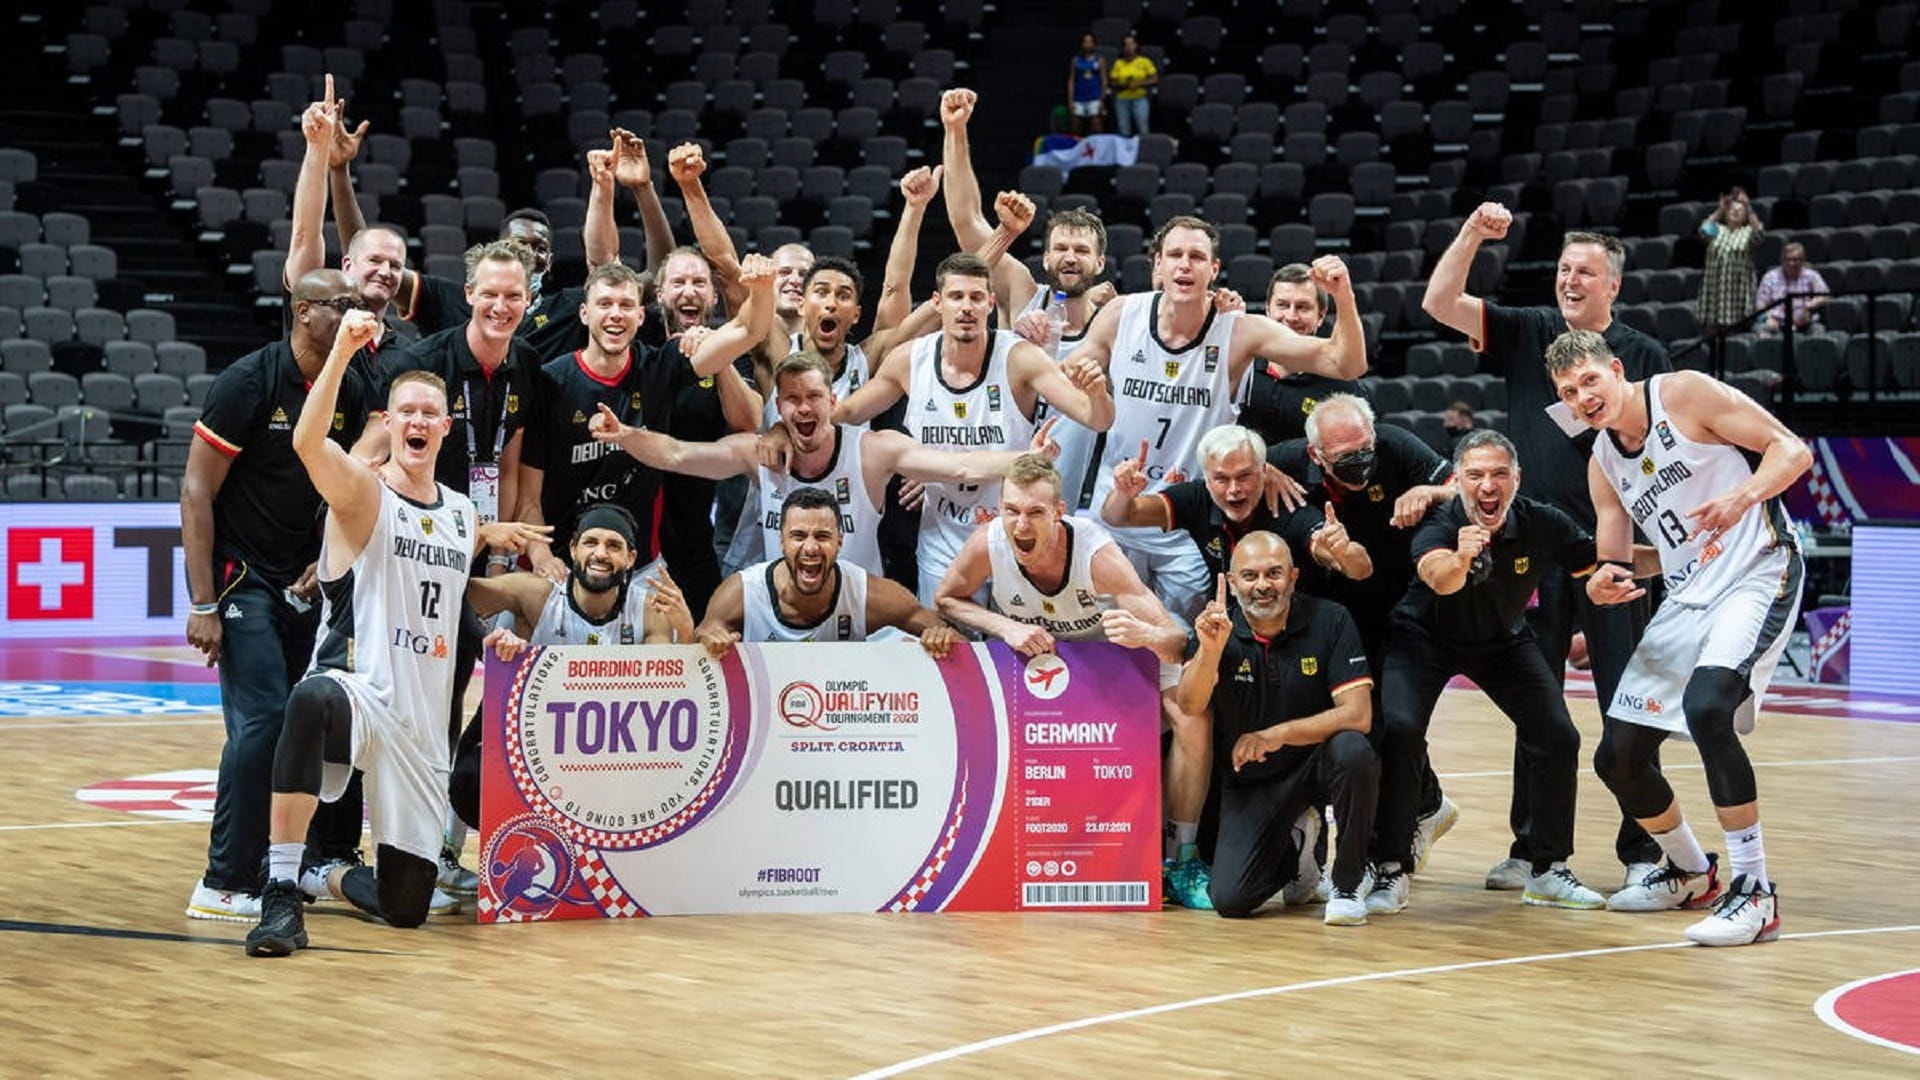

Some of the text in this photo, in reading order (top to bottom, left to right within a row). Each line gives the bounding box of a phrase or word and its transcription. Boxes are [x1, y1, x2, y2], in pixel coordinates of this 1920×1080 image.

[1123, 378, 1211, 408] DEUTSCHLAND
[922, 425, 1005, 446] DEUTSCHLAND
[1155, 418, 1172, 450] 7
[1658, 509, 1688, 549] 13
[420, 581, 441, 619] 12
[568, 658, 684, 678] BOARDING PASS
[825, 681, 868, 691] OLYMPIC
[546, 699, 698, 755] TOKYO
[825, 713, 919, 724] TOURNAMENT 2020
[1025, 722, 1118, 745] GERMANY
[838, 741, 904, 752] CROATIA
[1025, 765, 1132, 779] BERLIN TOKYO
[775, 780, 918, 812] QUALIFIED
[565, 800, 582, 814] TO
[586, 810, 625, 828] GOING
[631, 812, 655, 824] ARE
